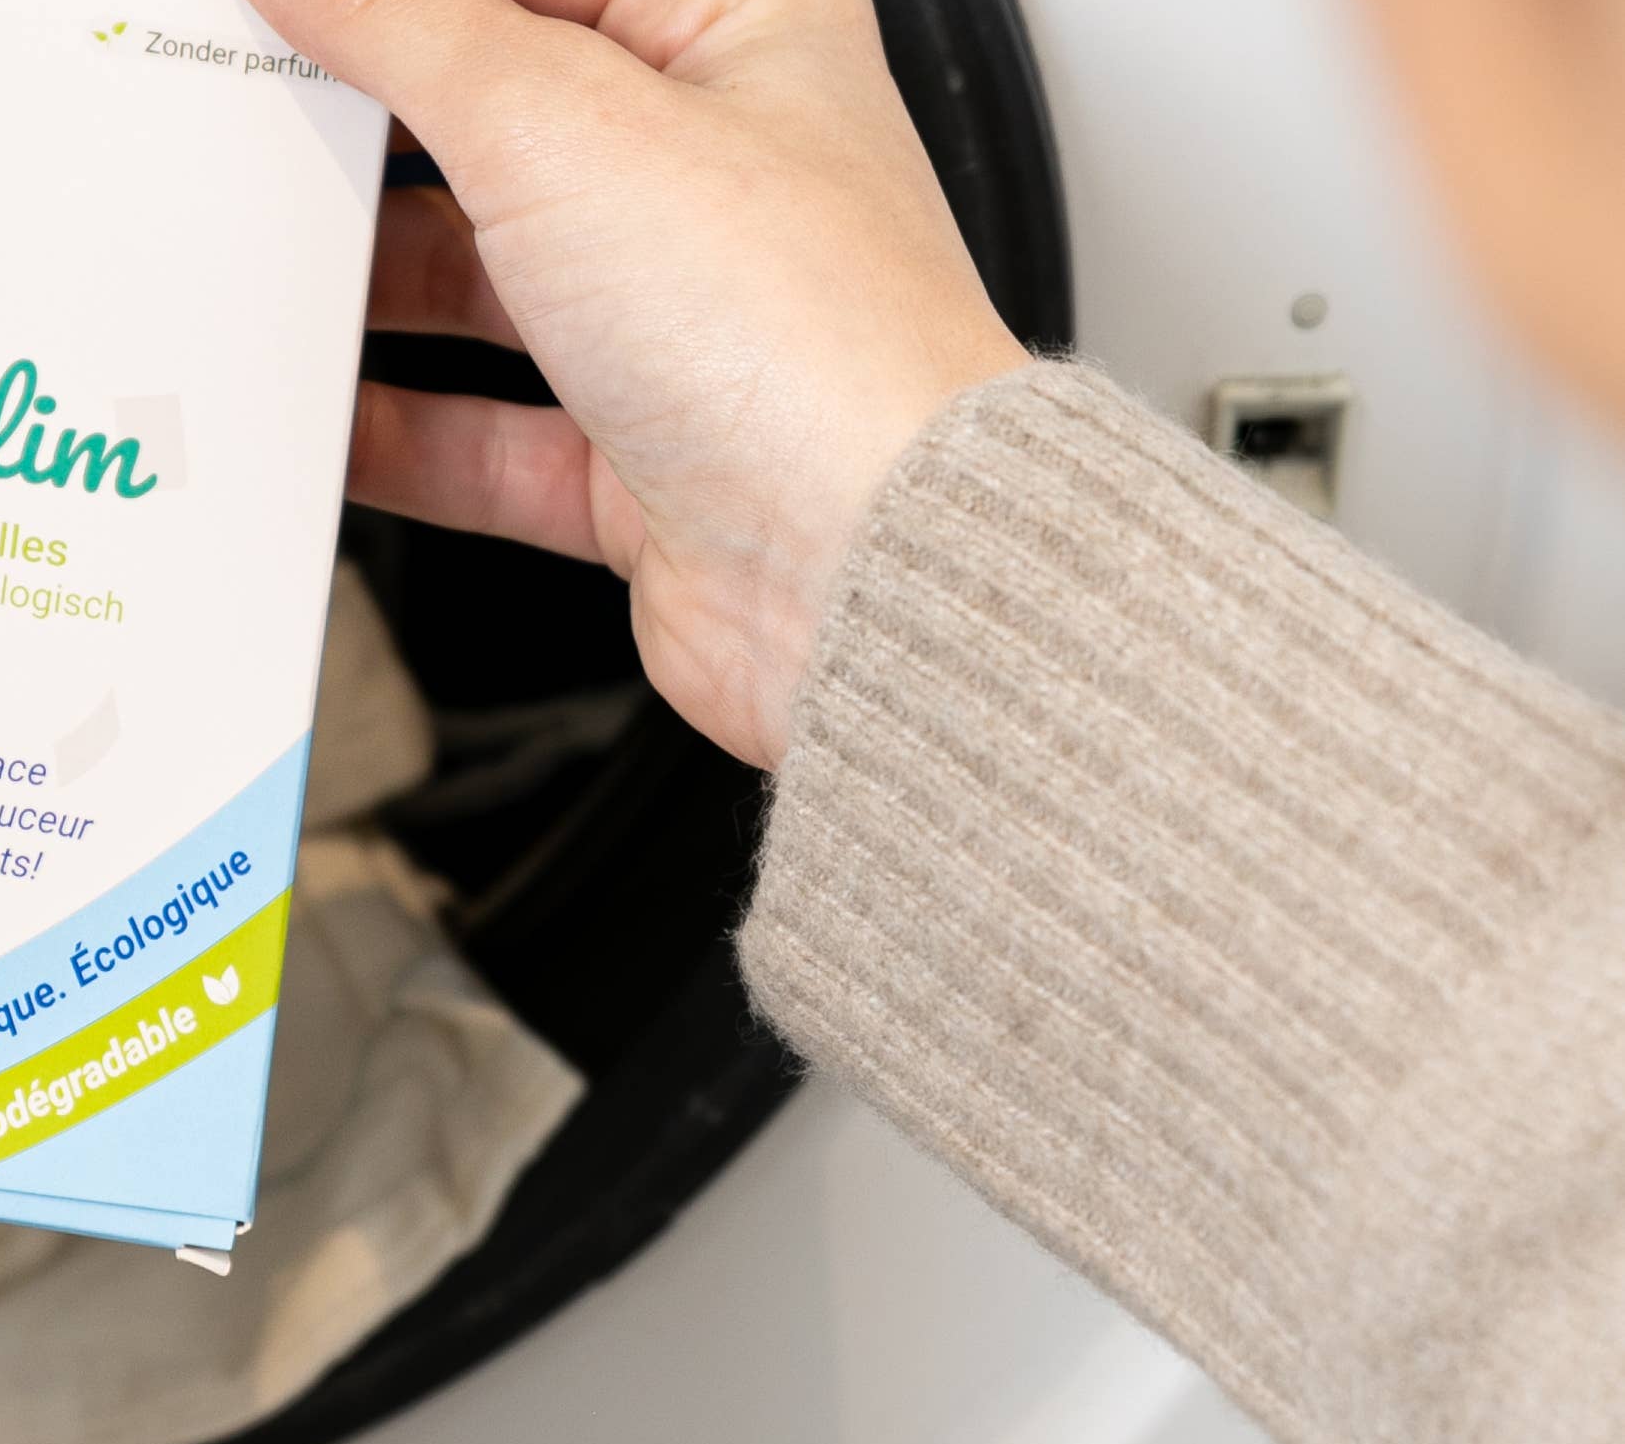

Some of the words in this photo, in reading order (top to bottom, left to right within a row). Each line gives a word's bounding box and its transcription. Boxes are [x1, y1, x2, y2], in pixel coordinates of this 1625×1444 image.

[145, 31, 237, 66] Zonder
[245, 53, 337, 82] parfu
[70, 851, 252, 987] Écologique
